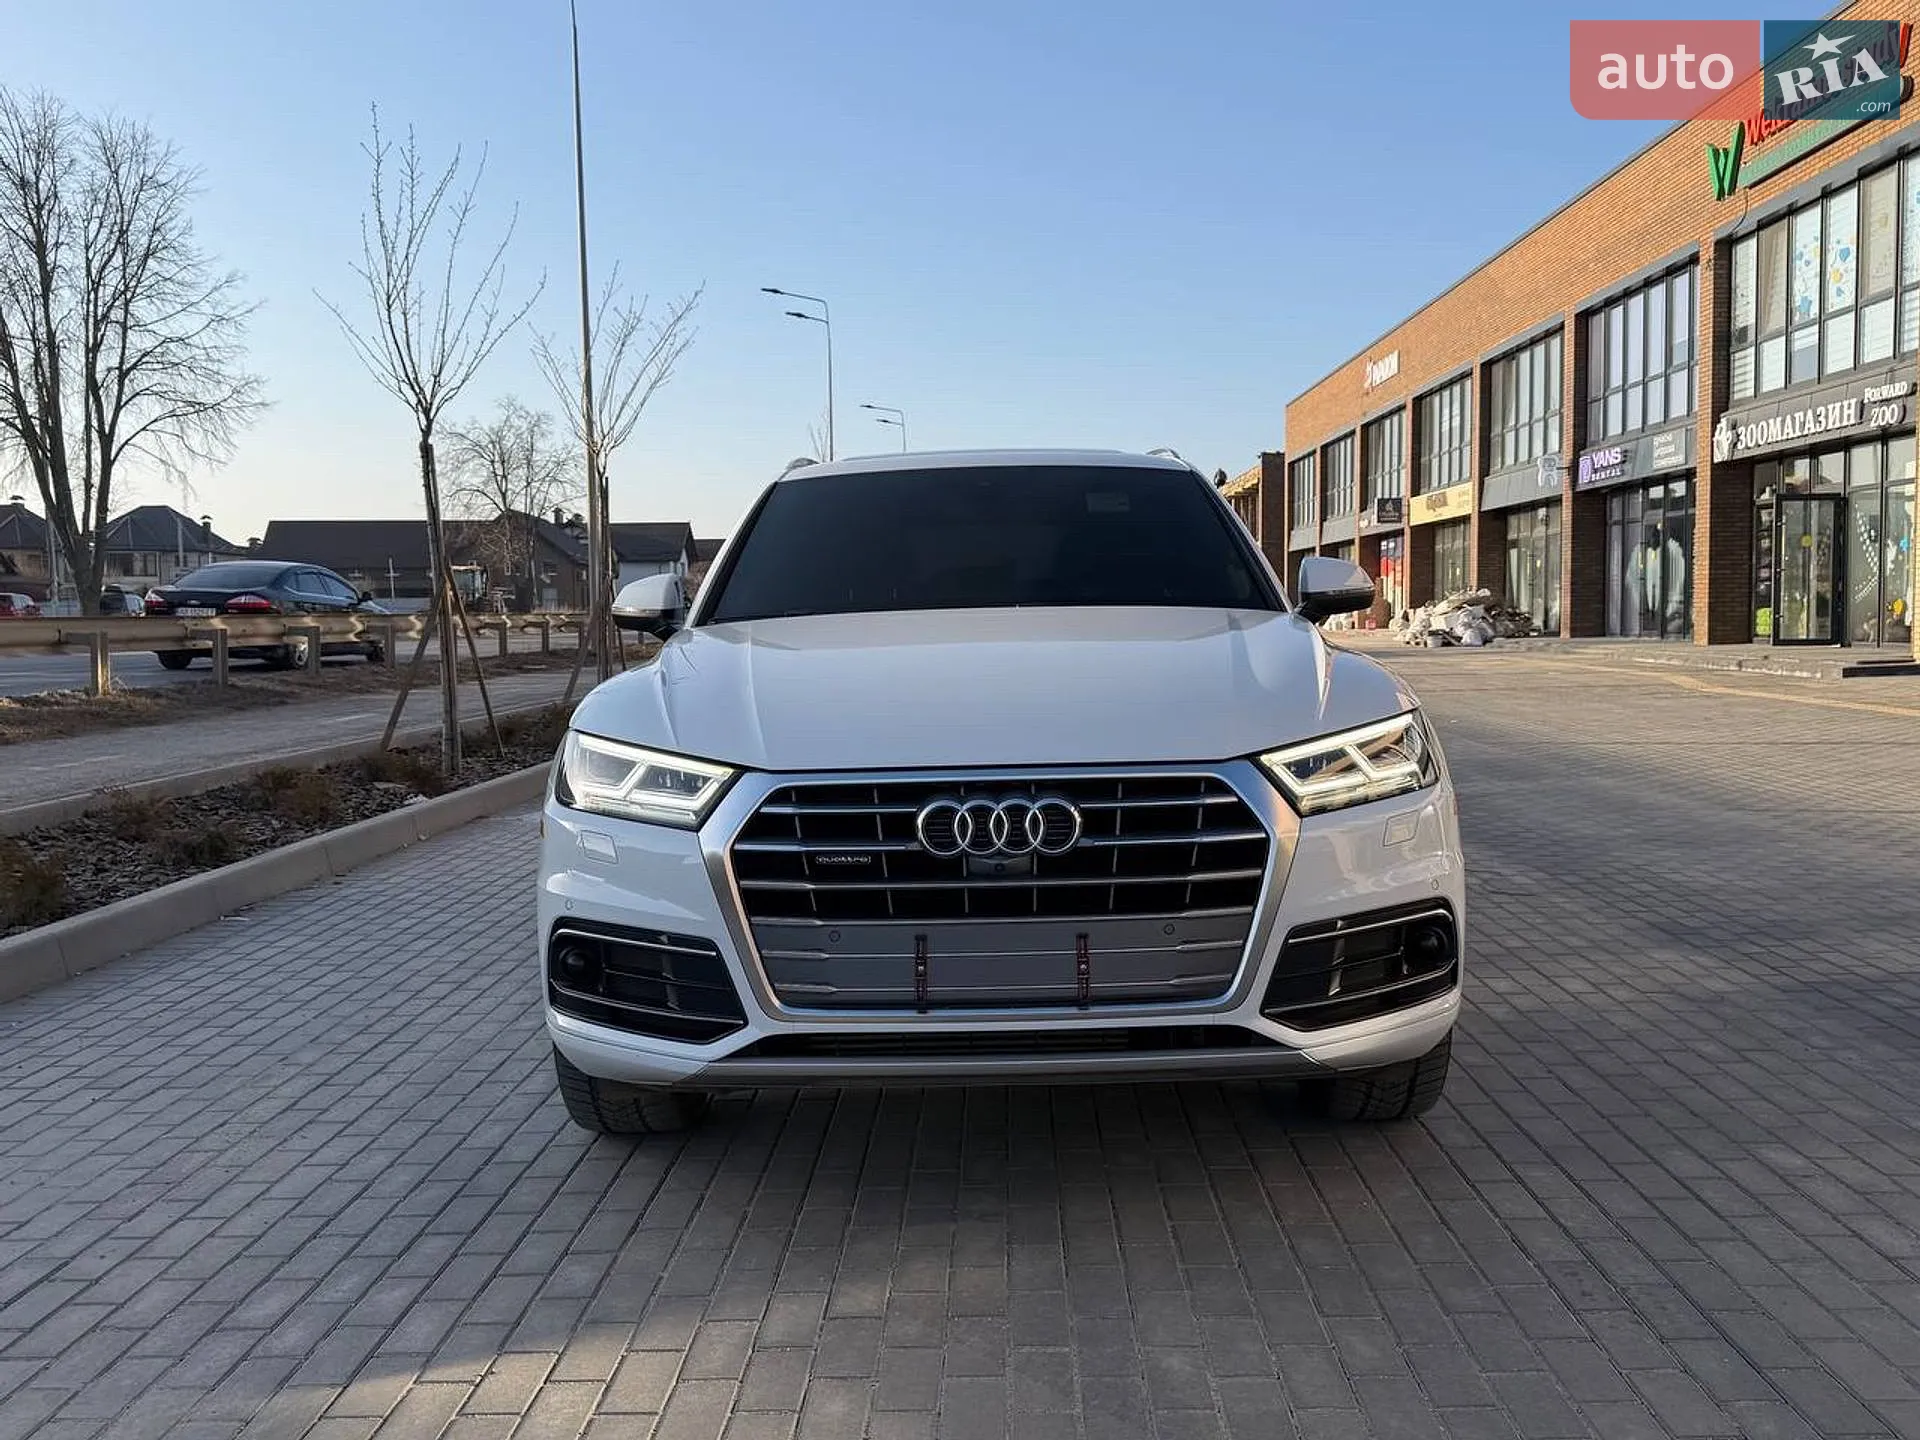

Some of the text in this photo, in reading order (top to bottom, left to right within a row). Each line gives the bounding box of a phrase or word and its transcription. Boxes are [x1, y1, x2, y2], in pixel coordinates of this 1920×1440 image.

[1737, 398, 1857, 450] ЗООМАГАЗИН
[1870, 403, 1898, 429] ZOO
[1592, 447, 1622, 468] YANS
